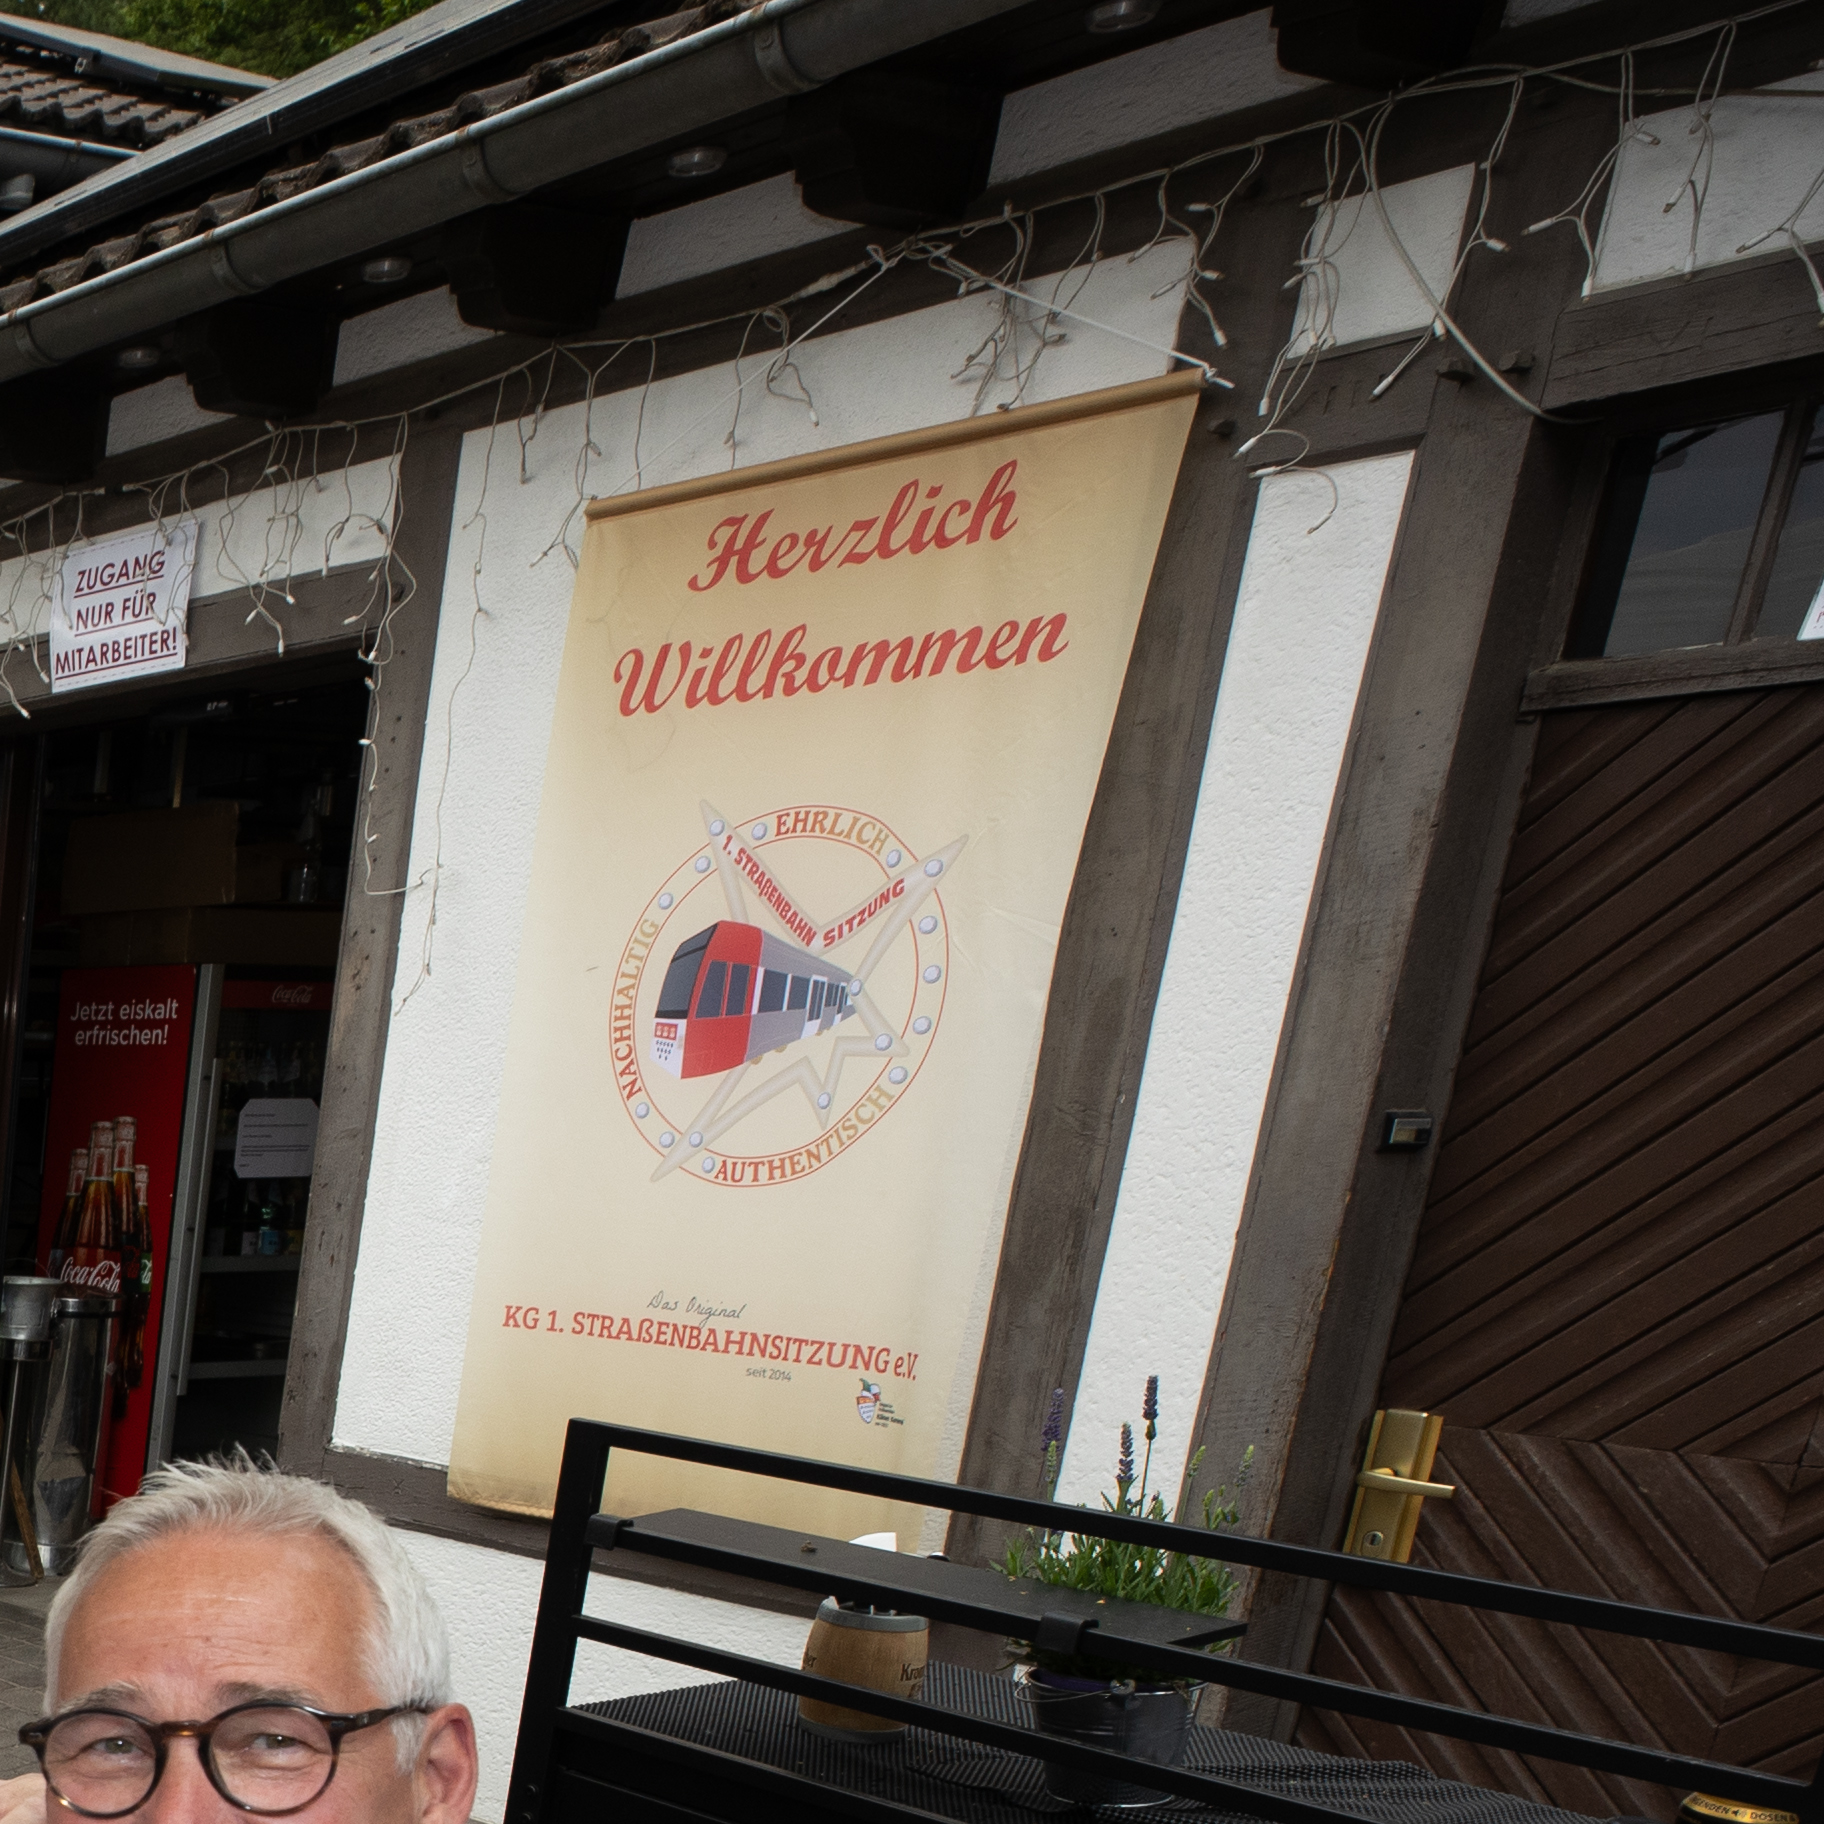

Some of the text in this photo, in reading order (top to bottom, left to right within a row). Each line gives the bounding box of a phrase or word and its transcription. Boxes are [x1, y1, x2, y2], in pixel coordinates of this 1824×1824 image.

[687, 459, 1019, 593] Herzlich
[74, 550, 166, 593] ZUGANG
[75, 590, 158, 630] NUR FÜR
[55, 627, 179, 676] MITARBEITER!
[613, 611, 1069, 718] Willkommen
[774, 809, 892, 856] EHRLICH
[732, 848, 818, 949] STRAßENBAHN
[822, 877, 908, 951] SITZUNG
[70, 998, 179, 1022] Jetzt eiskalt
[612, 917, 660, 1101] NACHHALTIG
[75, 1025, 170, 1046] erfrischen!
[714, 1083, 896, 1185] AUTHENTISCH
[646, 1290, 748, 1330] Das Original
[502, 1304, 919, 1382] KG 1. STRAßENBAHNSITZUNG e.V.
[745, 1366, 792, 1382] seit 2014
